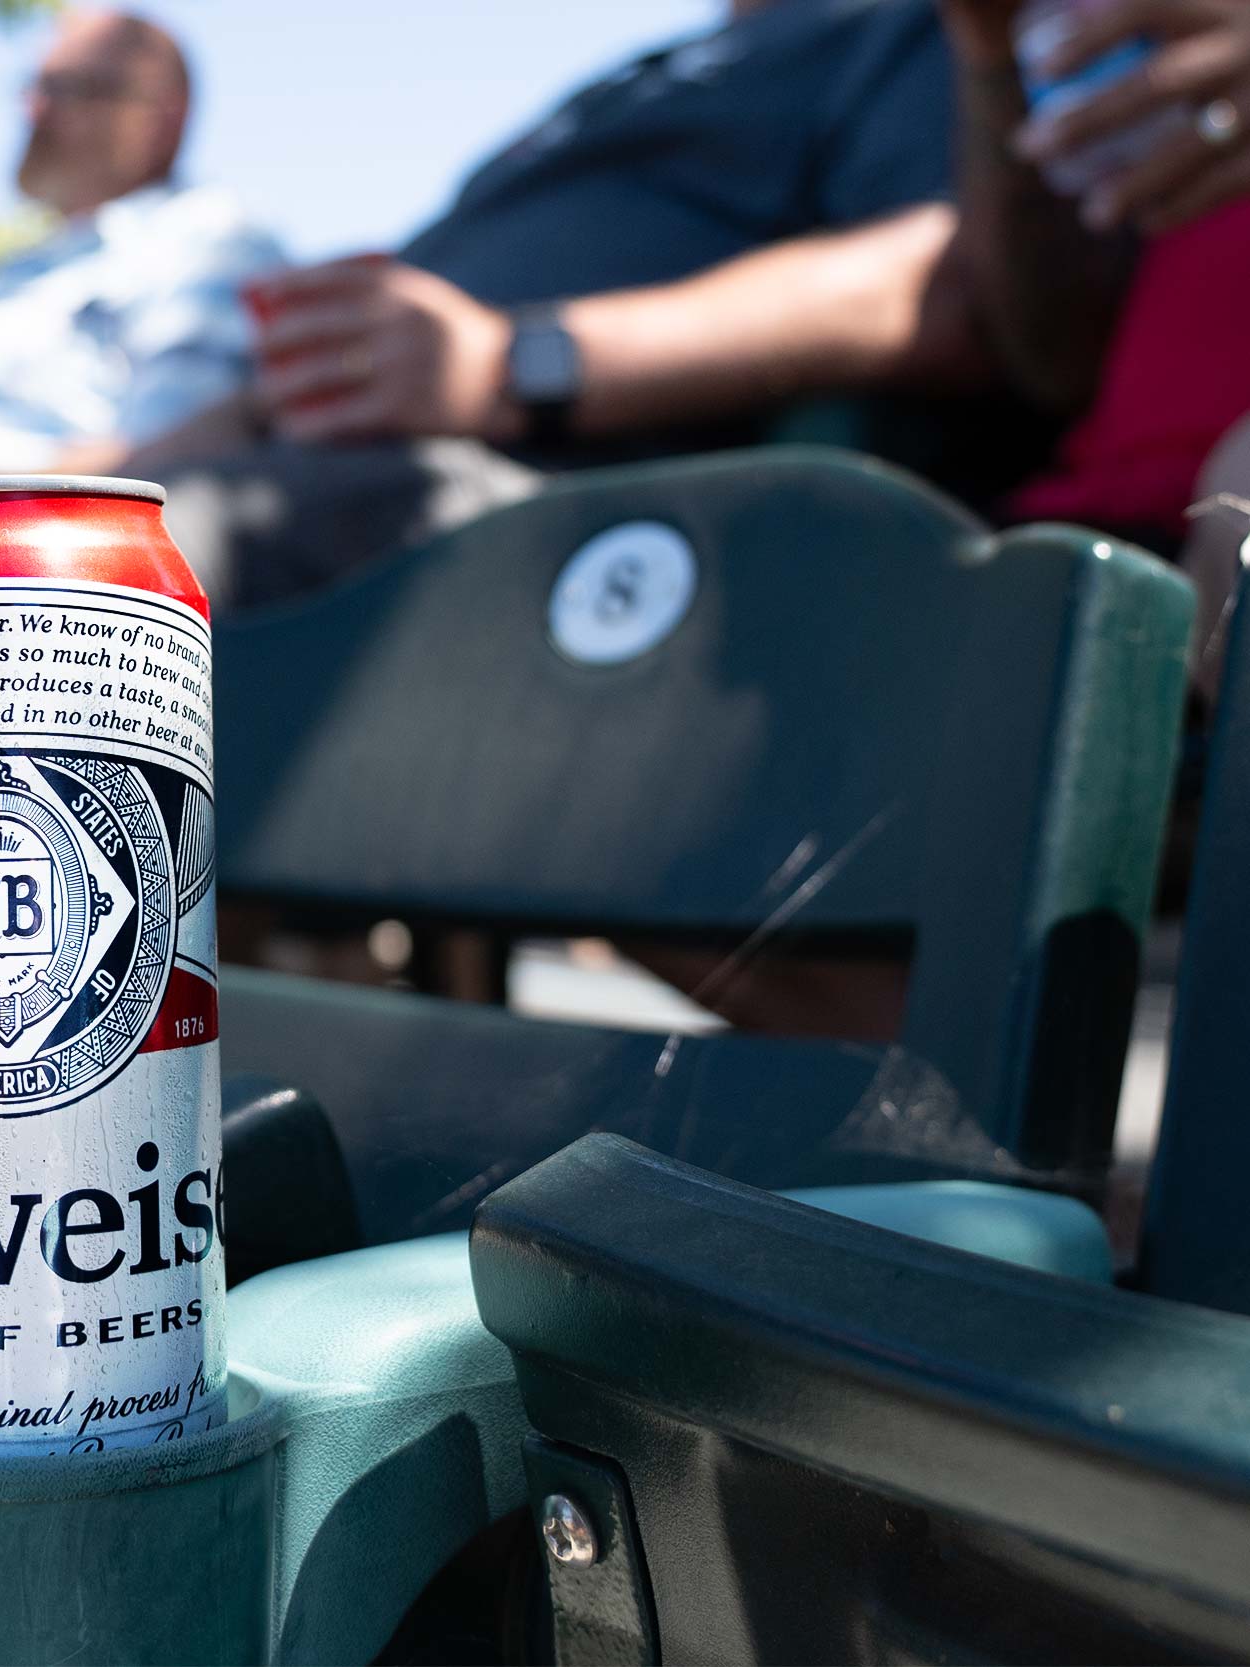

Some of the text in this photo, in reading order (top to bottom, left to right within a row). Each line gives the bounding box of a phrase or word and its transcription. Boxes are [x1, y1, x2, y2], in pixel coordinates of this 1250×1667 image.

[20, 614, 53, 633] We
[60, 615, 117, 639] know
[121, 625, 143, 647] of
[144, 632, 164, 649] no
[168, 635, 200, 668] brand
[18, 647, 44, 662] so
[52, 648, 111, 668] much
[118, 653, 137, 672] to
[143, 656, 180, 684] brew
[182, 675, 201, 697] and
[23, 703, 45, 723] in
[54, 708, 82, 725] no
[88, 710, 141, 733] other
[145, 717, 178, 744] beer
[180, 734, 192, 751] at
[100, 682, 112, 698] a
[119, 682, 166, 713] taste,
[170, 699, 179, 714] a
[181, 704, 210, 738] smoo
[70, 791, 124, 859] STATES
[8, 961, 36, 987] MARK
[92, 968, 117, 1004] OF
[174, 1019, 205, 1040] 1876
[56, 1299, 203, 1348] BEERS
[80, 1383, 180, 1437] process
